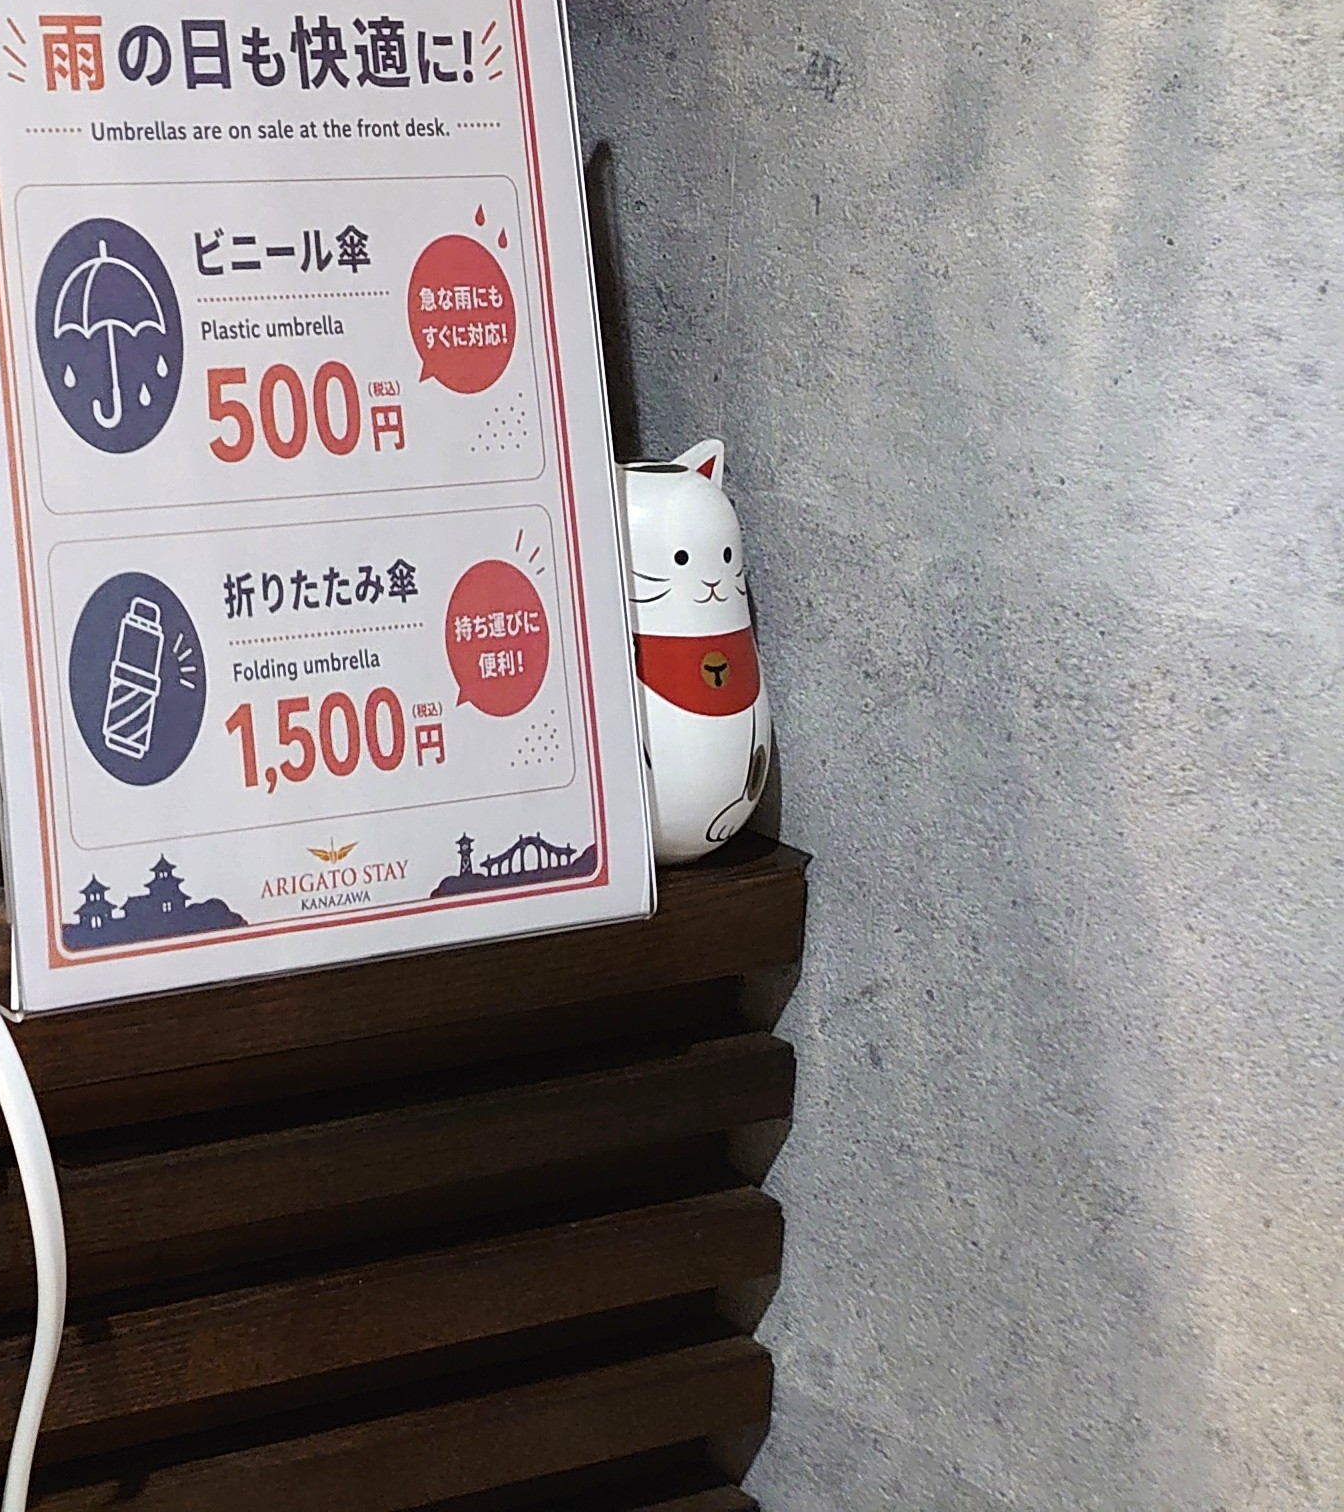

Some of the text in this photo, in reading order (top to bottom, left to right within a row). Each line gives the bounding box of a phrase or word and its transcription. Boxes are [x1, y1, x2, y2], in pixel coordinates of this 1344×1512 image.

[39, 14, 475, 92] 雨の日も快適に!
[91, 119, 451, 142] Umbrellas are on sale at the front desk.
[193, 224, 371, 276] ビニール傘
[418, 285, 504, 311] 急な雨にも
[200, 315, 344, 341] Plastic umbrella
[421, 321, 508, 348] すぐに対応!
[206, 361, 361, 463] 500
[370, 404, 406, 452] 円
[223, 558, 420, 620] 折りたたみ傘
[453, 608, 541, 642] 持ち運びに
[232, 649, 381, 684] Folding umbrella
[478, 652, 525, 679] 便利!
[225, 686, 405, 794] 1,500
[414, 723, 446, 767] 円
[260, 859, 410, 899] ARIGATO STAY
[301, 890, 372, 912] KANAZAWA
